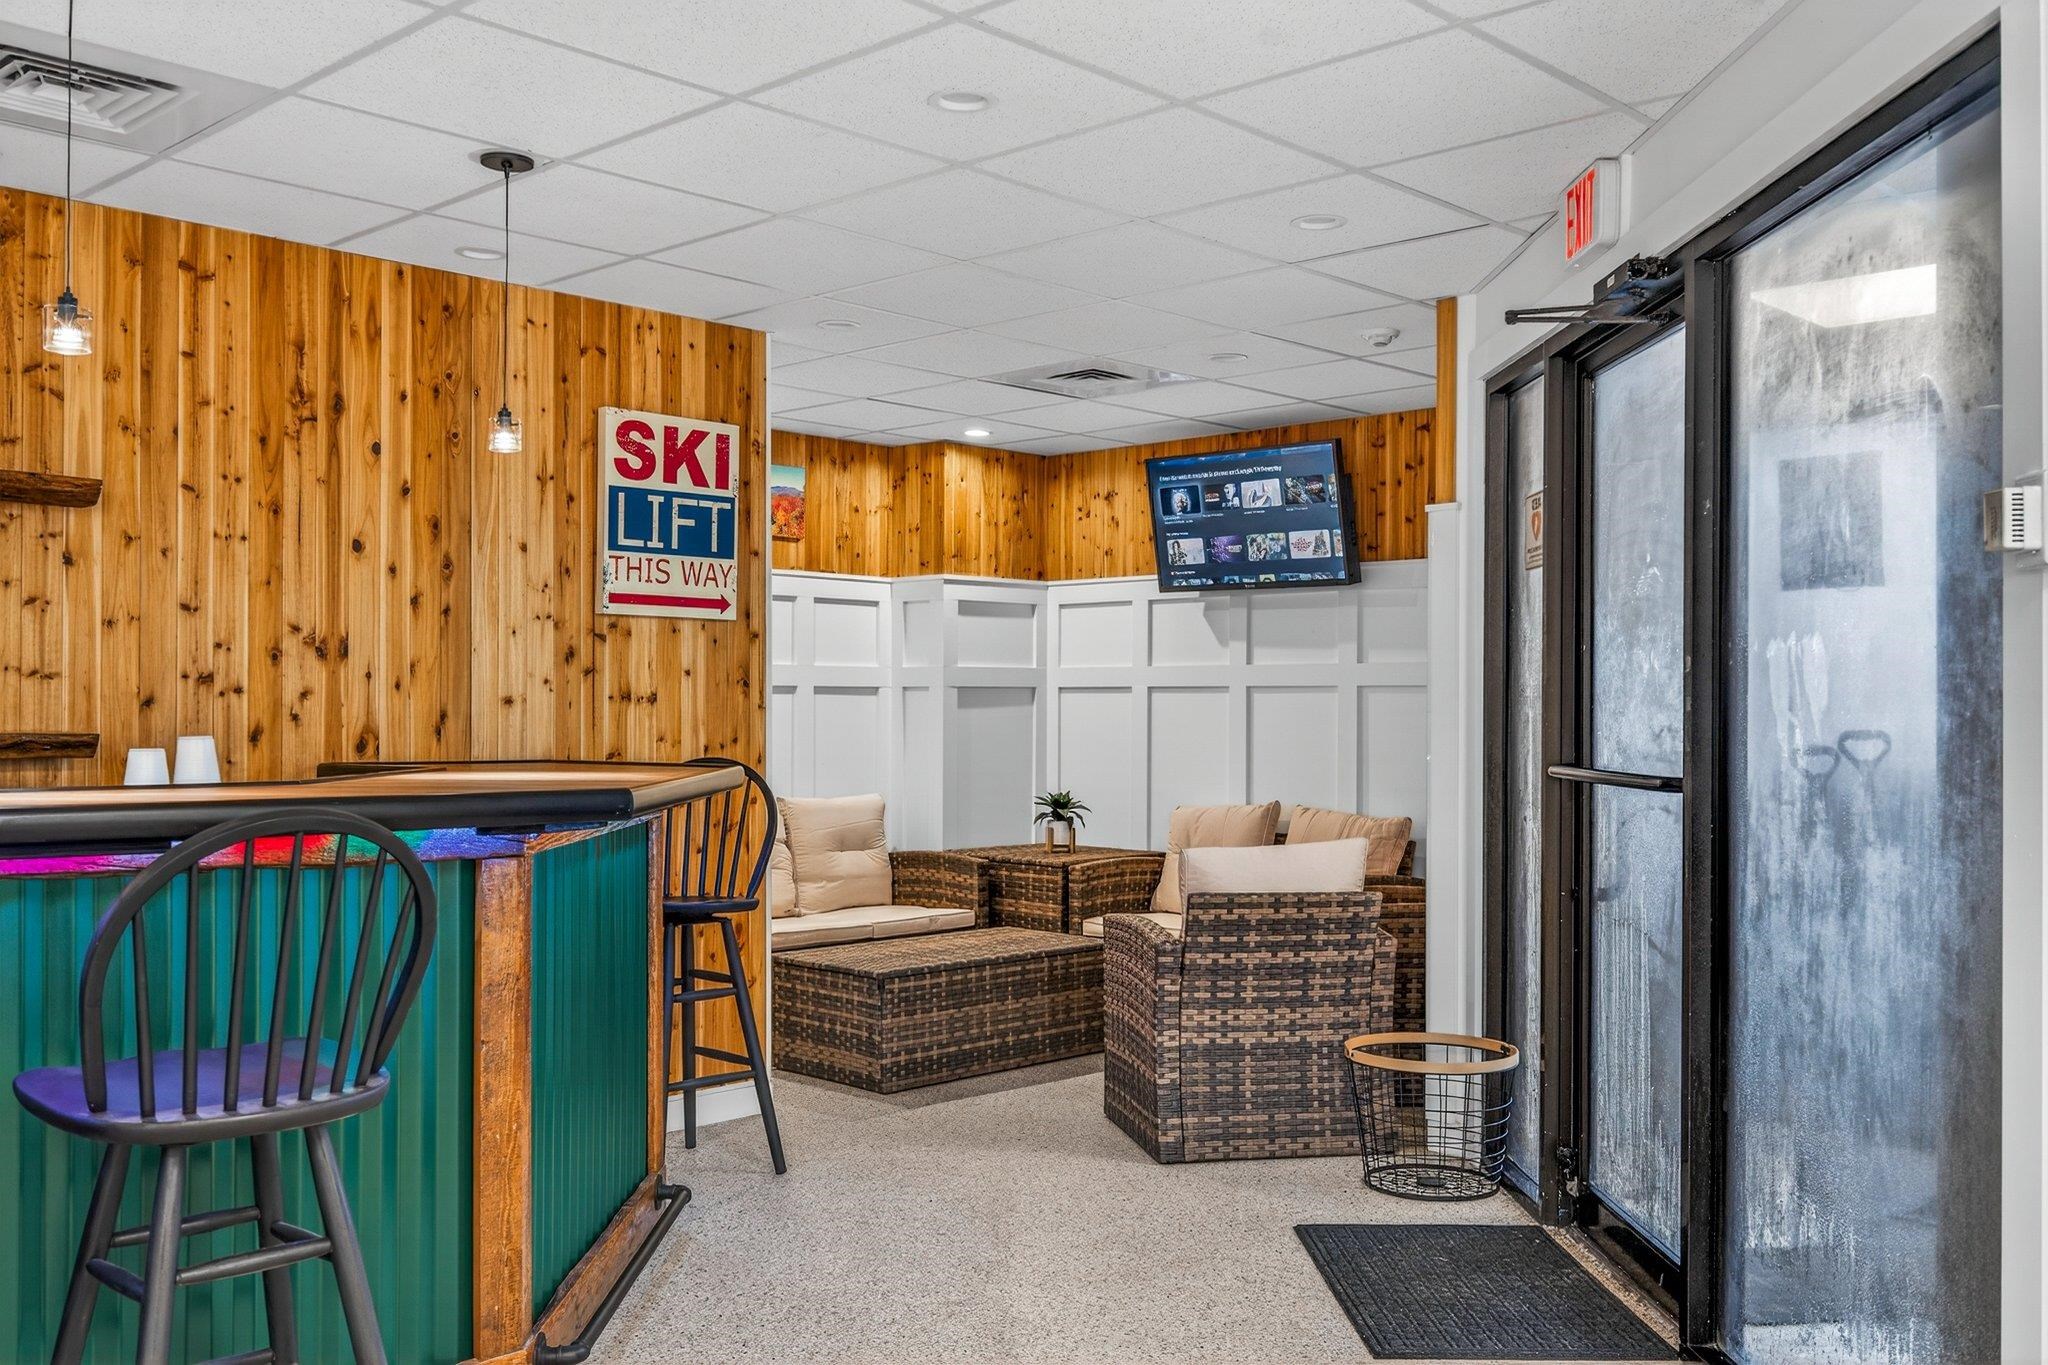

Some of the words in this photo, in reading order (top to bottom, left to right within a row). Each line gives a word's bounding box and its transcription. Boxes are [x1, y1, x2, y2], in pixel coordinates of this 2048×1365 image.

[1566, 167, 1595, 260] EXIT
[613, 419, 731, 490] SKI
[617, 492, 731, 553] LIFT
[608, 555, 671, 584] THIS
[681, 560, 733, 588] WAY
